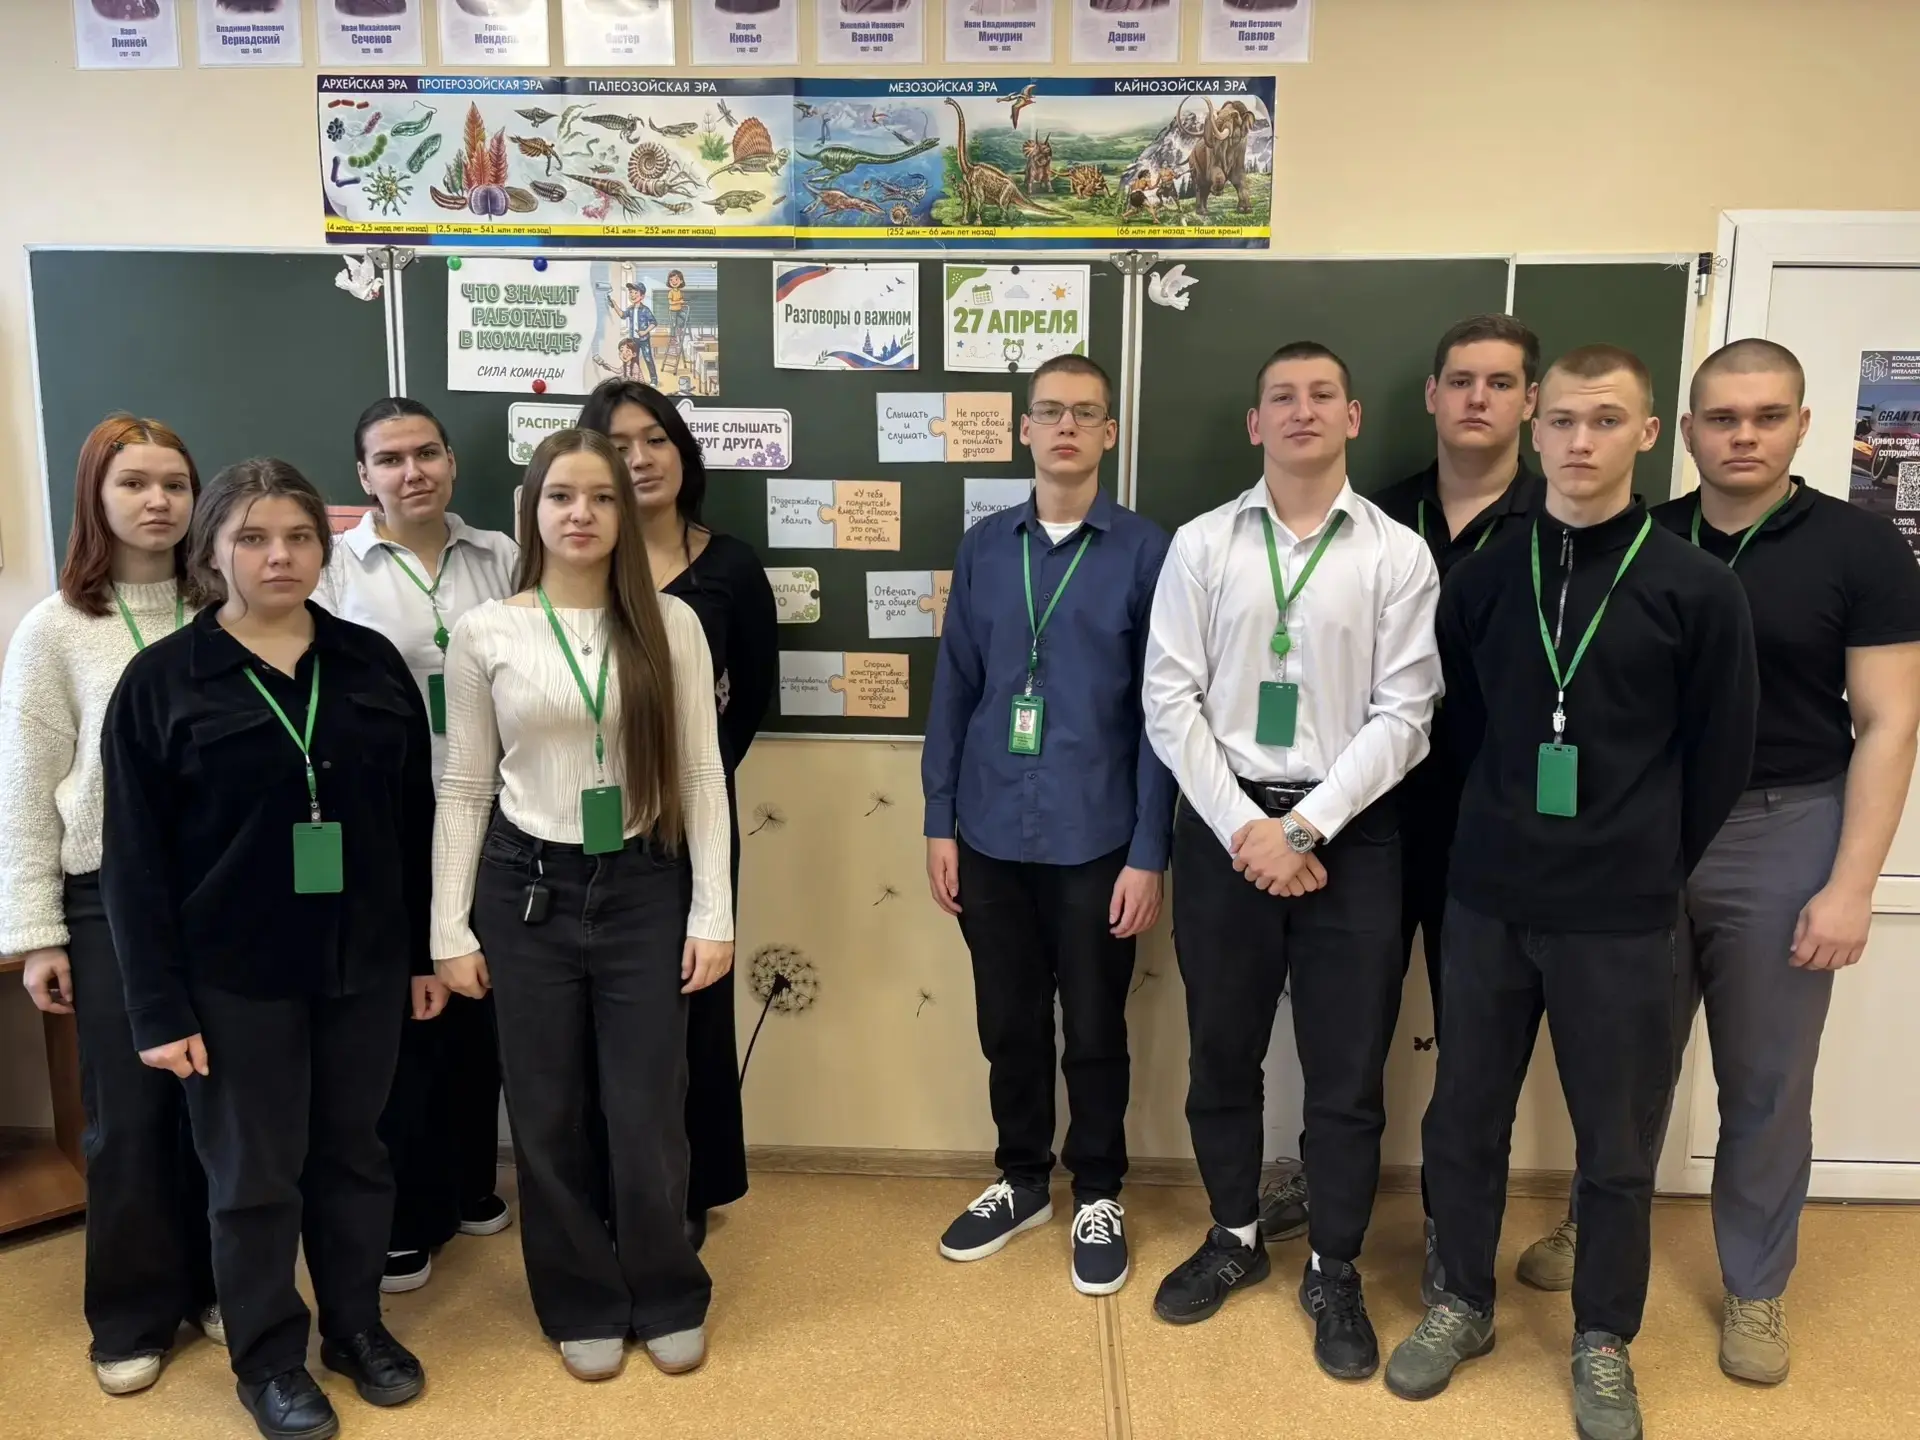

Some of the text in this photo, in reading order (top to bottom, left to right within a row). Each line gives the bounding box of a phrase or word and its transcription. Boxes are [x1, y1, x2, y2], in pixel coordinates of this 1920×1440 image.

[111, 36, 148, 48] Линней
[221, 33, 281, 47] Вернадский
[351, 33, 392, 45] Сеченов
[729, 32, 762, 44] Кювье
[851, 31, 894, 43] Вавилов
[978, 31, 1023, 43] Мичурин
[1107, 31, 1146, 44] Дарвин
[1238, 30, 1276, 42] Павлов
[322, 76, 408, 90] АРХЕЙСКАЯ ЭРА
[417, 77, 544, 91] ПРОТЕРОЗОЙСКАЯ ЭРА
[588, 79, 717, 93] ПАЛЕОЗОЙСКАЯ ЭРА
[888, 80, 998, 93] МЕЗОЗОЙСКАЯ ЭРА
[1114, 79, 1248, 93] КАЙНОЗОЙСКАЯ ЭРА
[327, 223, 334, 232] (4
[336, 225, 354, 234] млрд
[361, 224, 373, 233] 2,5
[436, 224, 451, 234] (2,5
[453, 226, 472, 235] млрд
[480, 225, 494, 233] 541
[527, 226, 551, 235] назад)
[602, 226, 619, 235] (541
[645, 226, 659, 234] 252
[691, 227, 717, 236] назад)
[886, 227, 904, 236] (252
[929, 227, 939, 235] 66
[971, 228, 997, 236] назад)
[1116, 227, 1130, 236] (66
[1194, 227, 1216, 235] Наше
[1218, 227, 1243, 236] время)
[461, 283, 580, 305] ЧТО ЗНАЧИТ
[472, 307, 567, 328] РАБОТАТЬ
[785, 303, 912, 328] Разговоры о важном
[953, 306, 1078, 334] 27 АПРЕЛЯ
[459, 330, 582, 354] В КОМАНДЕ?
[477, 365, 507, 377] СИЛА
[886, 406, 929, 419] Слышать
[956, 408, 1000, 421] Не просто
[1878, 410, 1909, 422] GRAN
[686, 421, 782, 433] ЕНИЕ СЛЫШАТЬ
[904, 422, 911, 430] и
[951, 418, 1005, 431] ждать своей
[887, 431, 928, 444] слушать
[961, 429, 999, 440] очереди,
[1867, 435, 1920, 446] Турнир среди
[698, 437, 764, 451] РУГ ДРУГА
[962, 438, 1003, 446] понимать
[962, 447, 996, 459] другого
[1878, 449, 1920, 459] сотрудник
[866, 489, 884, 498] тебя
[770, 496, 823, 508] Поддерживать
[838, 507, 865, 516] вместо
[781, 517, 813, 526] хвалить
[848, 515, 879, 525] Ошибка
[864, 533, 891, 545] провал
[874, 585, 917, 596] Отвечать
[776, 596, 788, 607] О
[874, 597, 917, 610] за общее
[886, 609, 906, 621] дело
[863, 659, 892, 671] Спорим
[874, 678, 907, 688] неправ
[857, 693, 897, 705] попробуем
[1217, 1260, 1246, 1287] N
[1307, 1286, 1327, 1313] N
